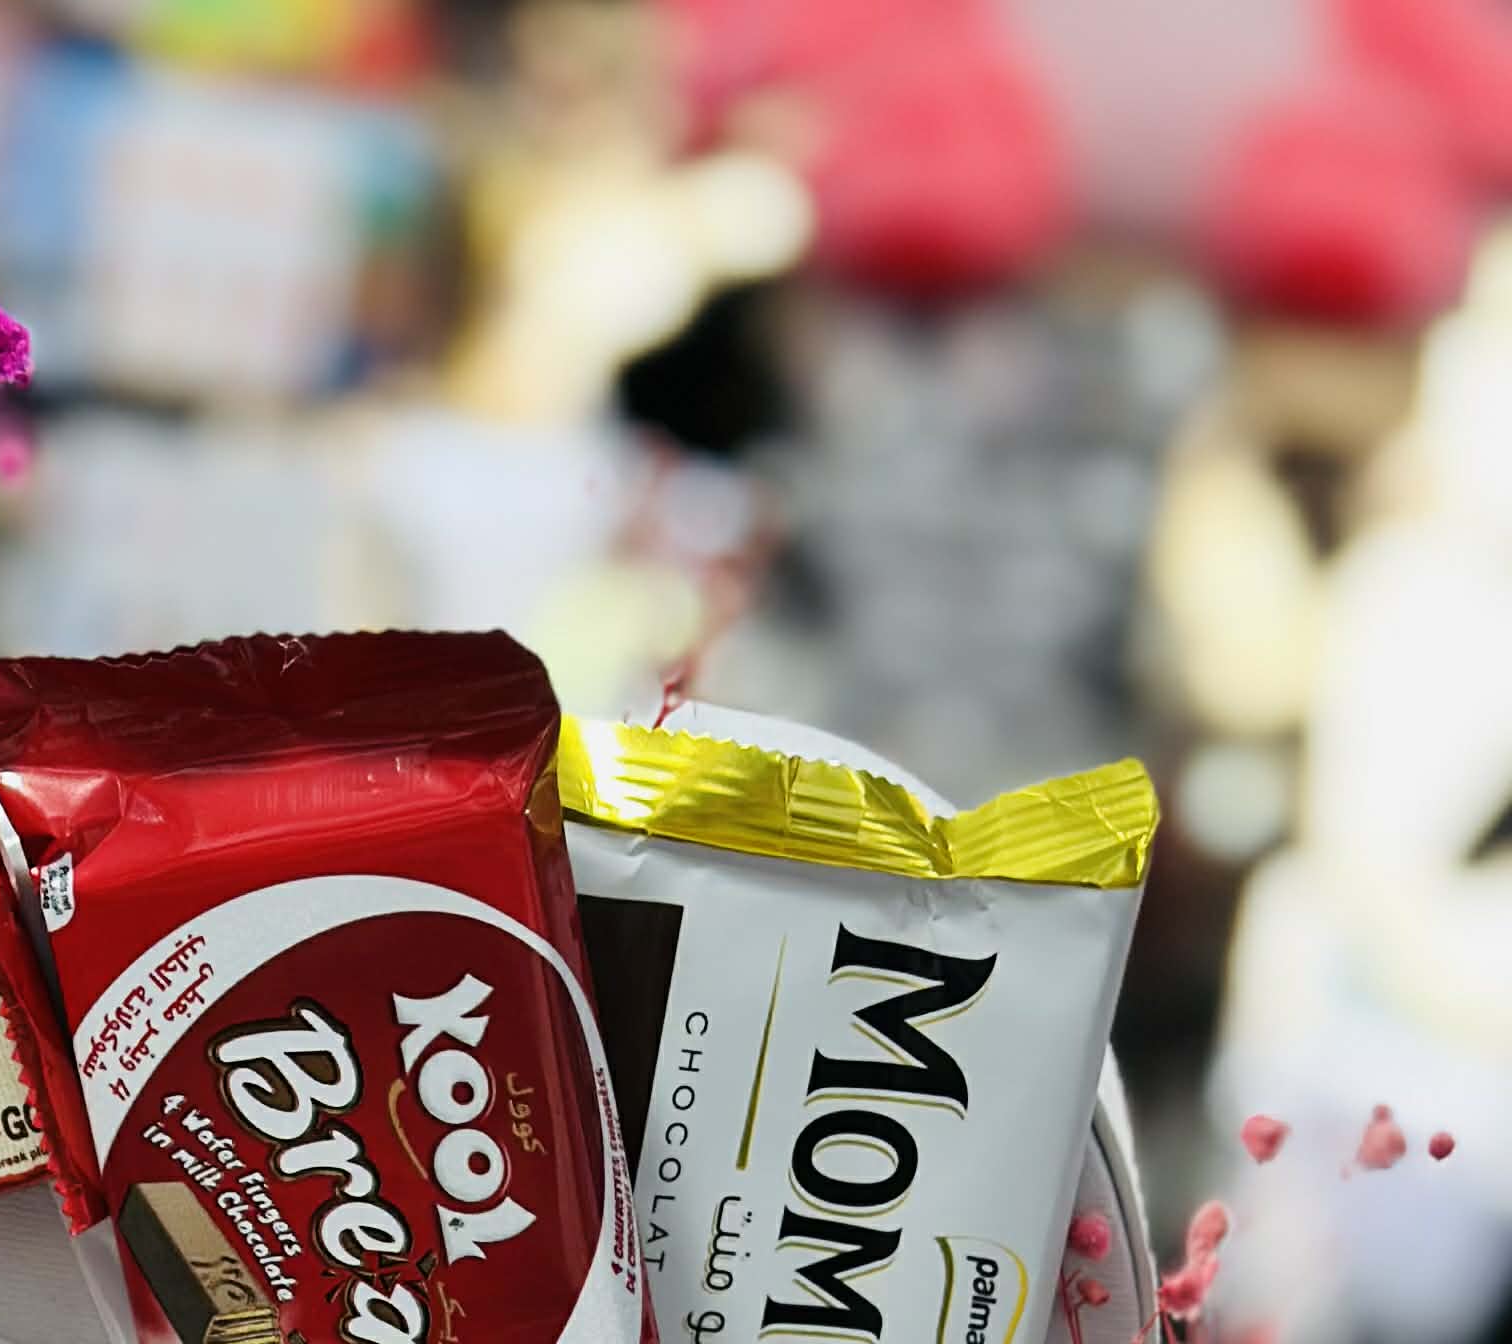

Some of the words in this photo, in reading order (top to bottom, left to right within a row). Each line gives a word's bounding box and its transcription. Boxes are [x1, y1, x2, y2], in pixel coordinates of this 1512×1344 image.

[143, 1122, 174, 1148] in
[217, 1191, 299, 1301] Chocolate
[163, 1095, 185, 1114] 4
[182, 1109, 246, 1169] Wafer
[239, 1172, 302, 1257] Fingers
[392, 973, 537, 1265] KOOL
[645, 1011, 709, 1273] CHOCOLAT
